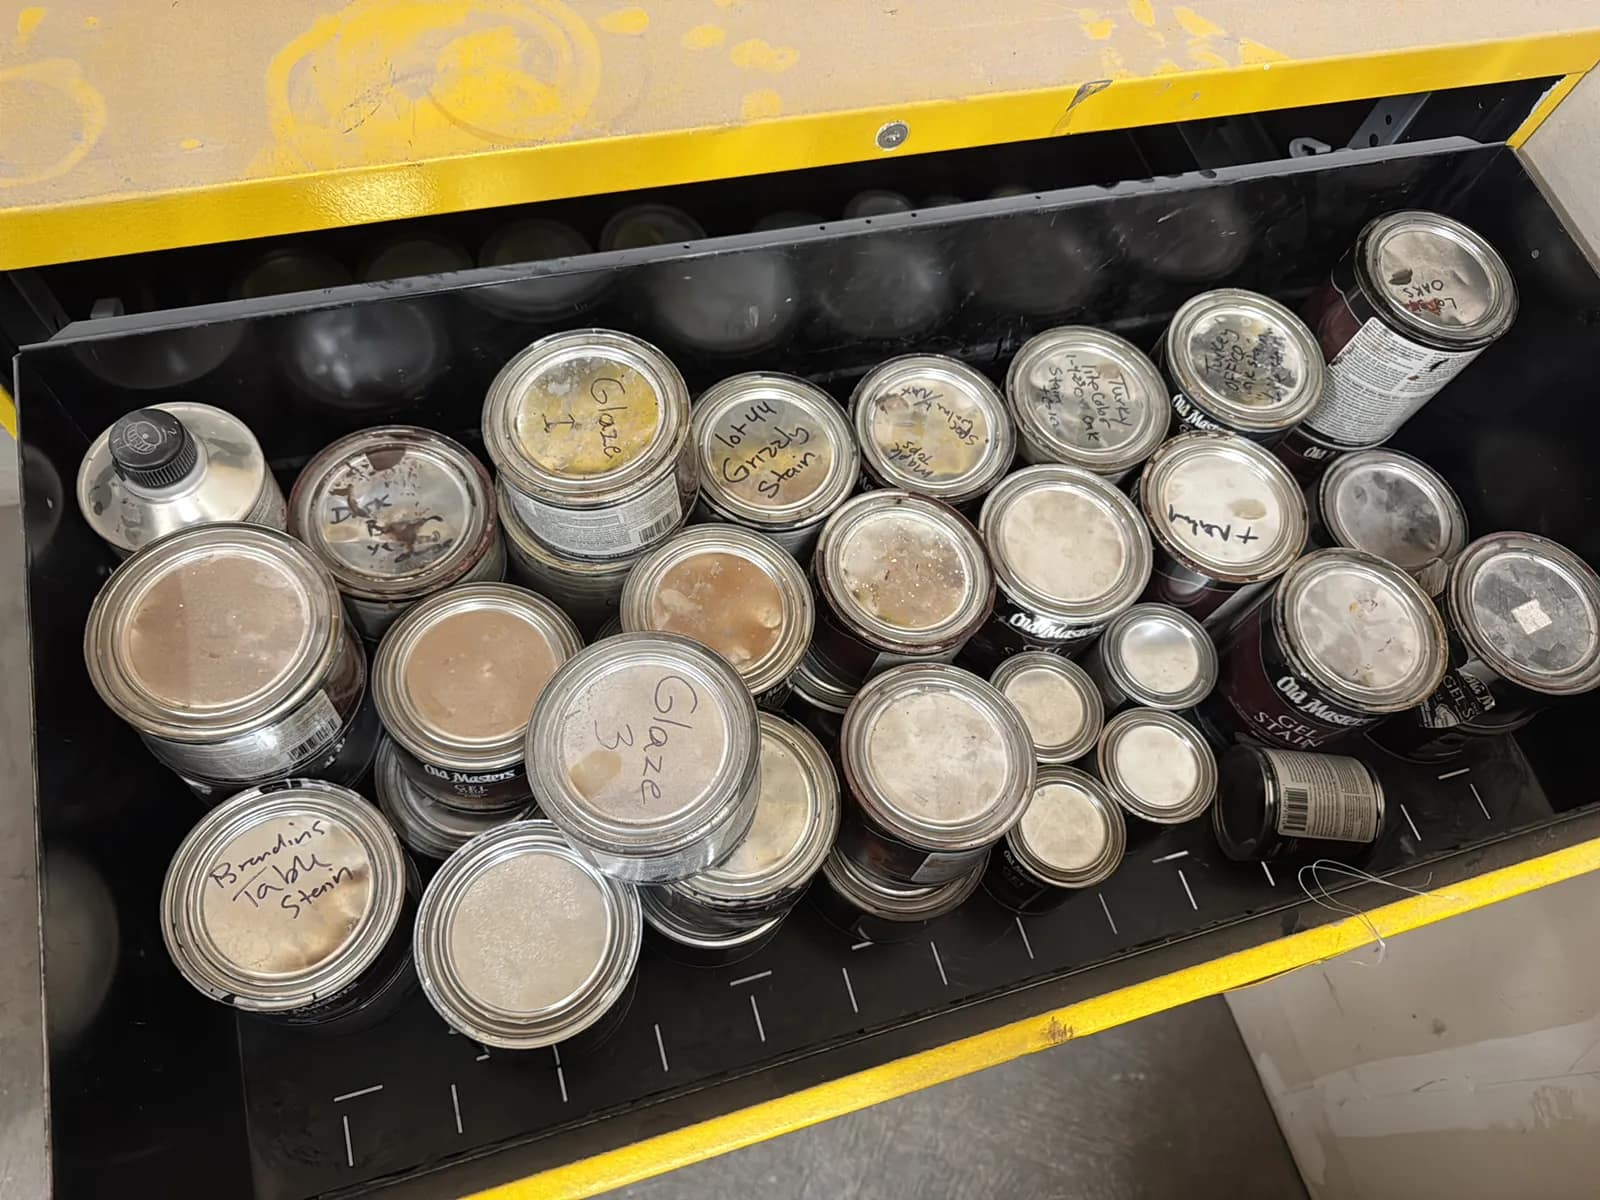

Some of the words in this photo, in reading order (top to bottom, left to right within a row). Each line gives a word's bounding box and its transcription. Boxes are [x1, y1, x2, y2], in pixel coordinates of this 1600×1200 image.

[1403, 279, 1444, 298] OAKS
[590, 377, 628, 459] Glaze
[723, 426, 810, 483] Grizzly
[758, 452, 816, 499] Stain
[1009, 612, 1042, 635] Old
[1276, 676, 1308, 704] Old
[1443, 675, 1466, 706] GEL
[594, 719, 634, 750] 3
[642, 675, 698, 805] Glaze
[1254, 711, 1324, 749] STAIN
[1278, 715, 1317, 739] GEL
[424, 764, 451, 781] Old
[450, 770, 516, 784] Masters
